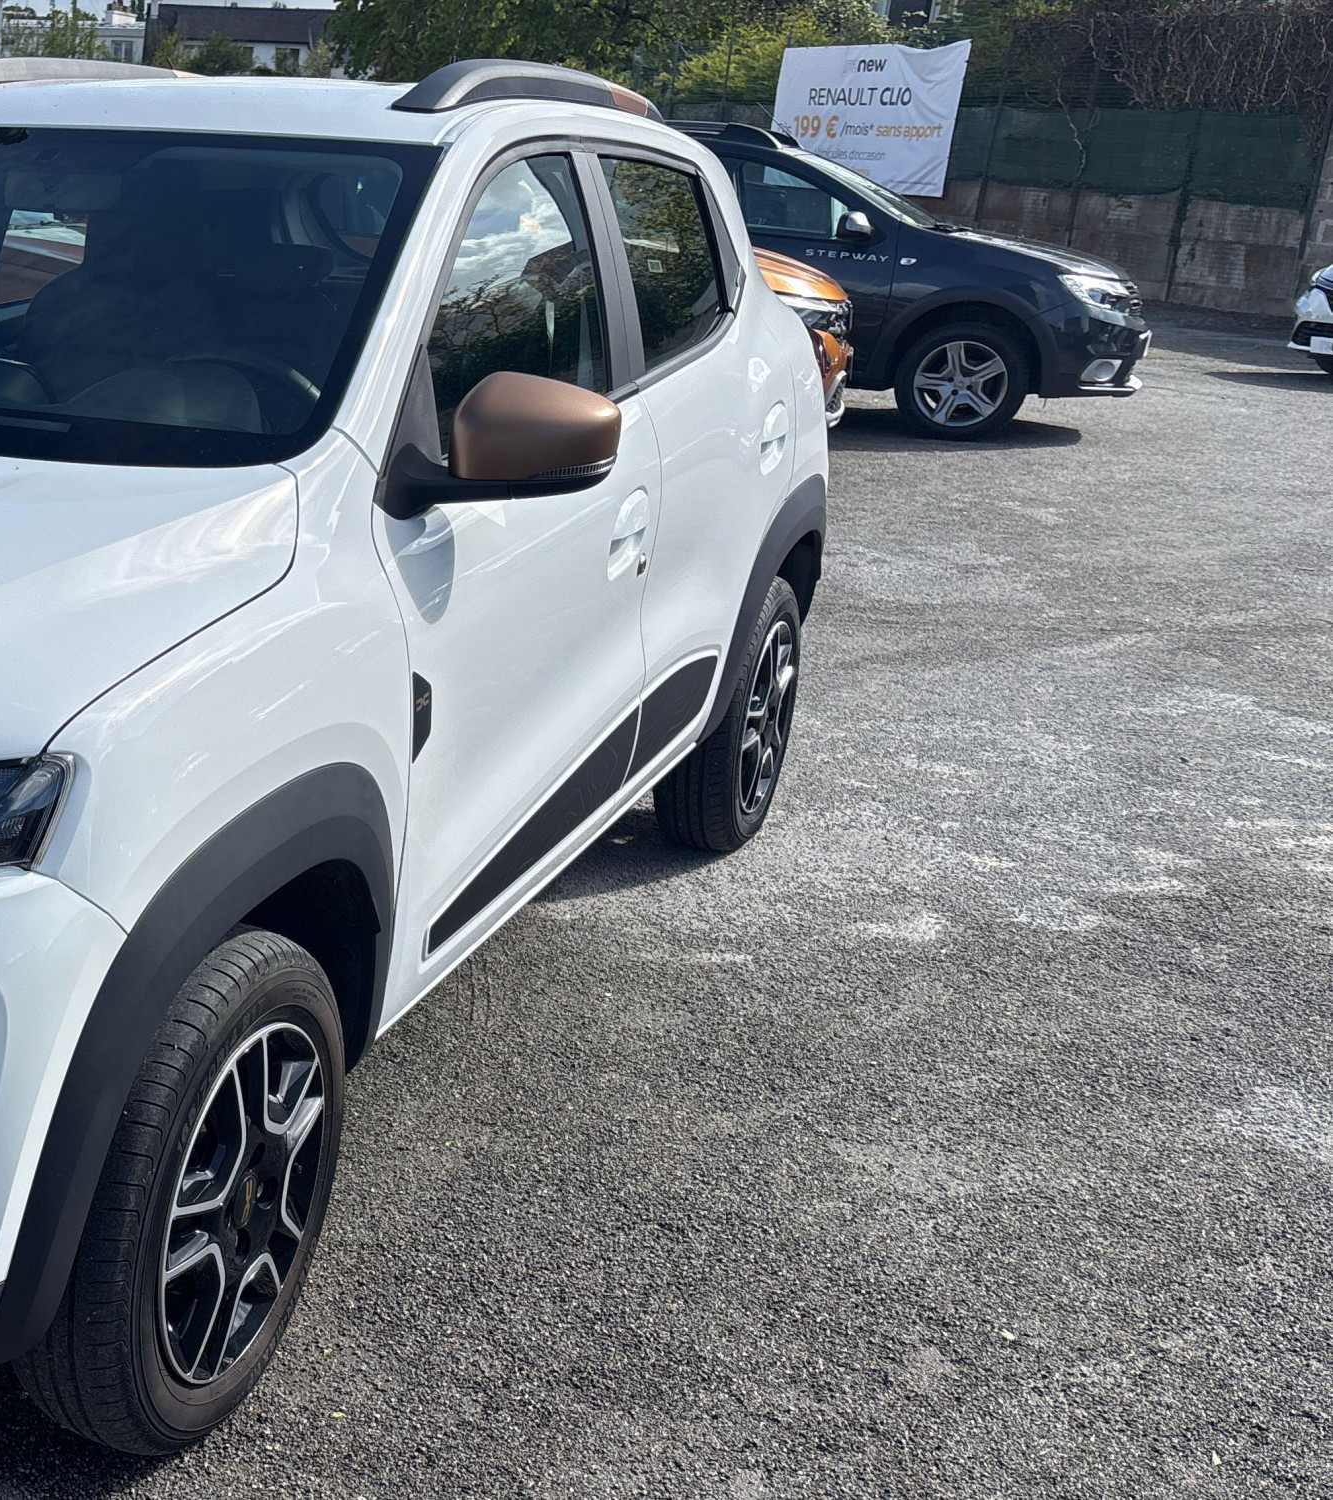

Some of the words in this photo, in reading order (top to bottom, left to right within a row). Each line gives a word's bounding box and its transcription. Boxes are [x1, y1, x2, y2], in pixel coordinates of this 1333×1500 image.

[808, 87, 878, 106] RENAULT
[879, 86, 912, 106] CLIO
[793, 115, 820, 138] 199
[825, 115, 839, 138] €
[875, 125, 903, 138] sans
[904, 123, 943, 142] apport
[805, 248, 890, 263] STEPWAY
